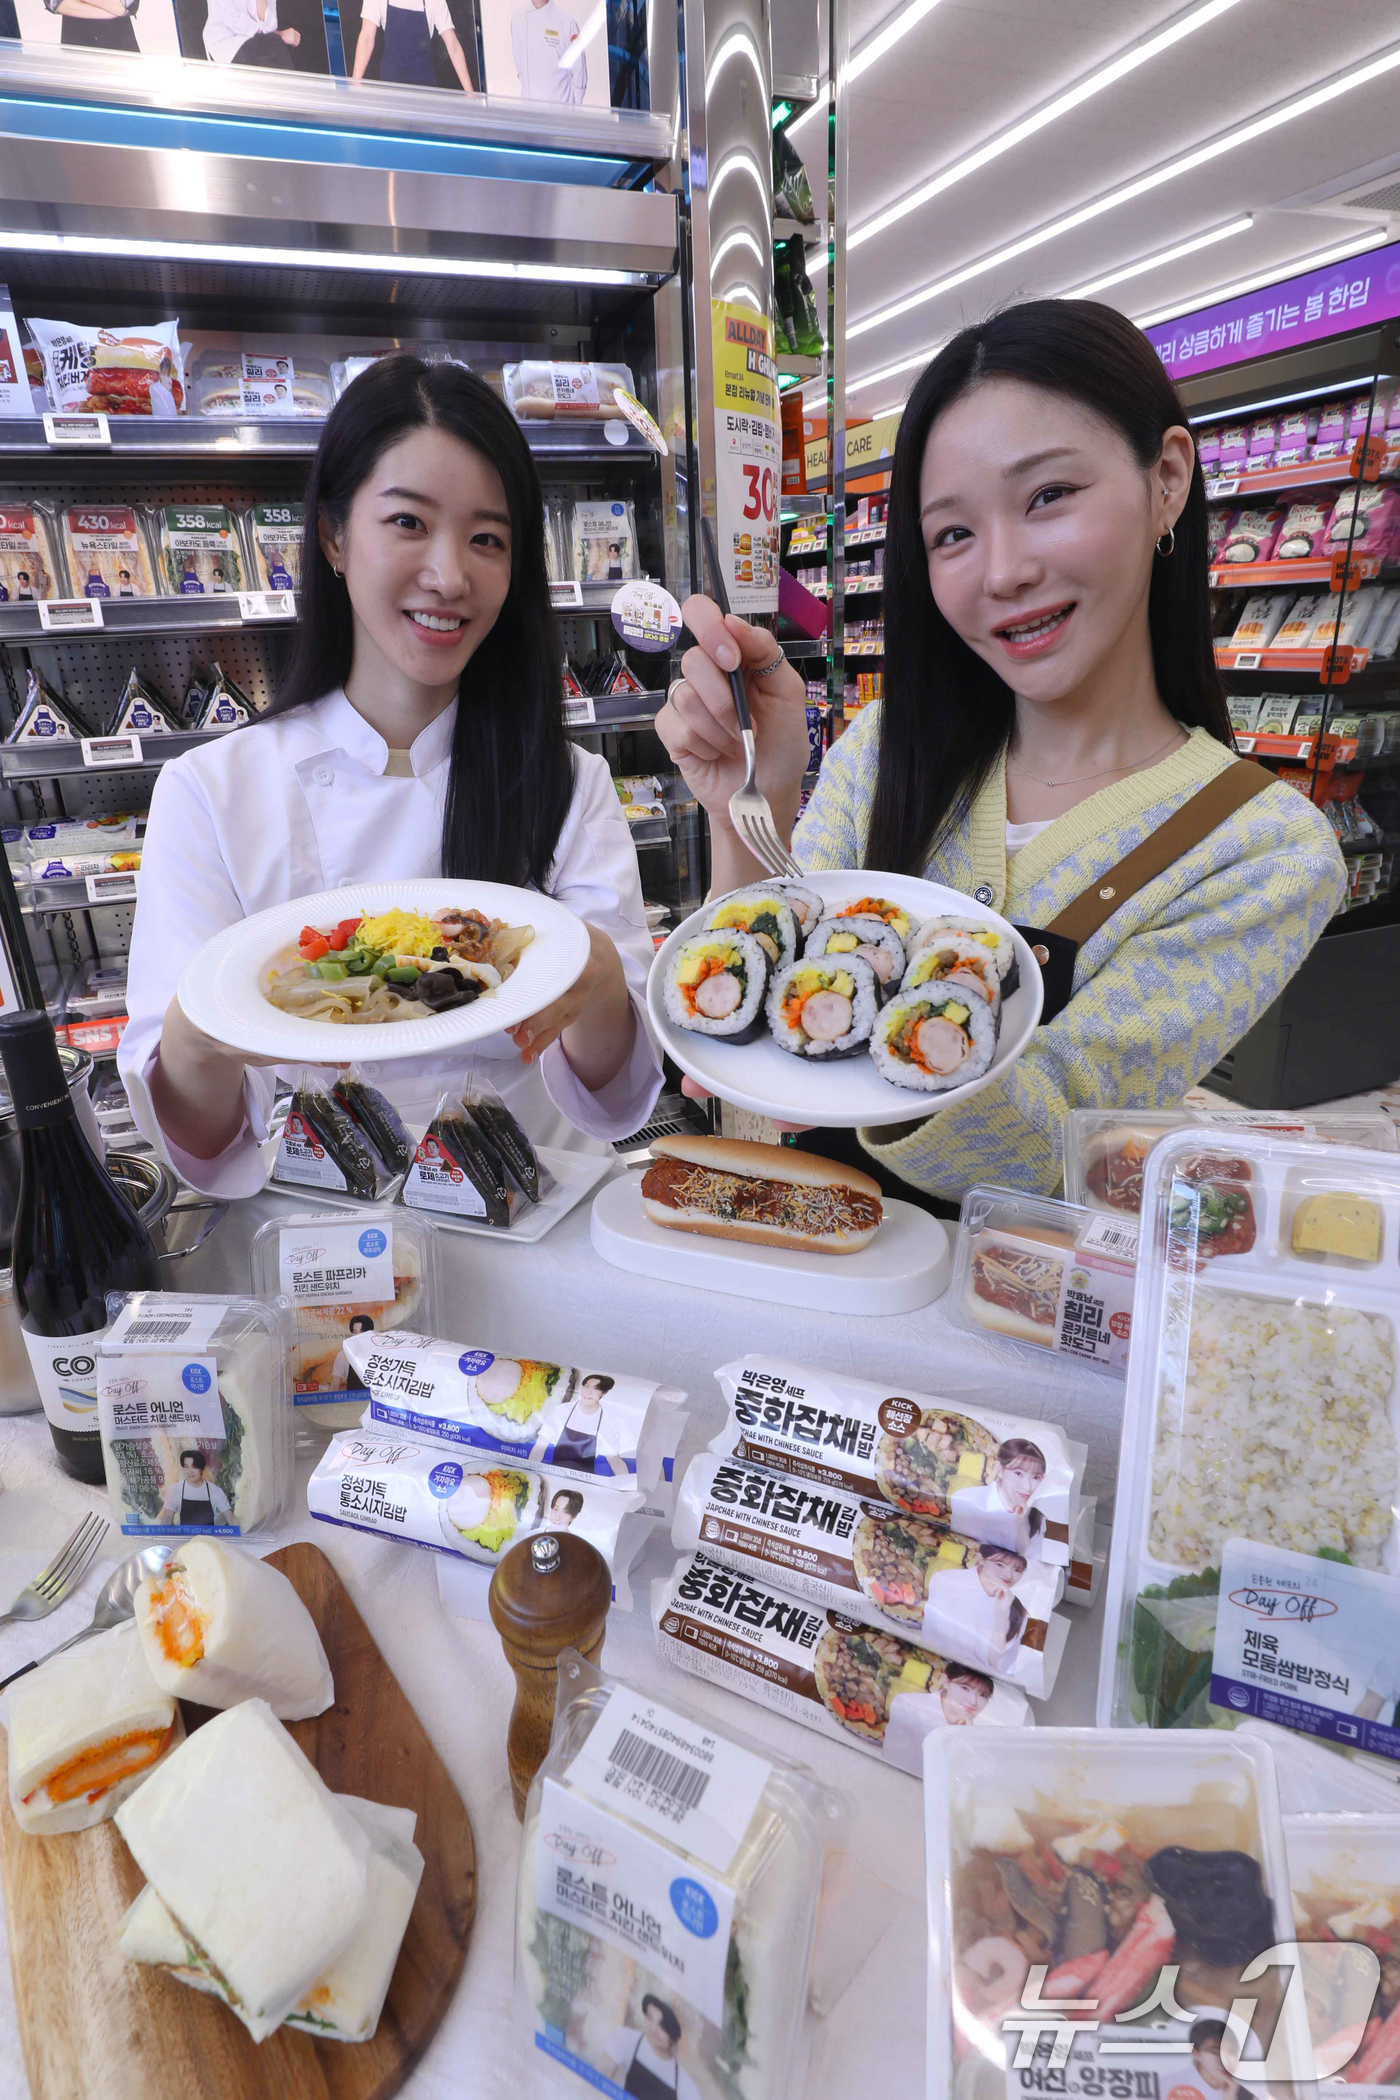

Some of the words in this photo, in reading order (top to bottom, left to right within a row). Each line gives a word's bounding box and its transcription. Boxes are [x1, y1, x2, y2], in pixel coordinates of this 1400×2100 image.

[1179, 318, 1243, 361] 상큼하게
[1246, 303, 1300, 340] 즐기는
[1304, 291, 1324, 323] 봄
[1328, 277, 1371, 316] 한입
[727, 320, 766, 350] ALLDAY
[725, 384, 738, 398] 본점
[739, 385, 756, 402] 리뉴얼
[847, 435, 873, 457] CARE
[78, 515, 110, 530] 430
[111, 521, 127, 530] kcal
[176, 514, 206, 529] 358
[206, 521, 222, 529] kcal
[263, 508, 292, 523] 358
[8, 520, 25, 530] kcal
[81, 541, 119, 550] 뉴욕스타일
[175, 539, 202, 548] 아보카도
[263, 534, 289, 542] 아보카도
[73, 1027, 112, 1046] SNS
[25, 1097, 65, 1112] CONVENIENT
[286, 1146, 300, 1155] 로제
[419, 1171, 435, 1181] 로제
[353, 1186, 359, 1195] 2
[288, 1255, 304, 1264] Day
[306, 1249, 319, 1262] Off
[293, 1270, 324, 1284] 로스트
[325, 1267, 367, 1282] 파프리카
[293, 1284, 309, 1293] 치킨
[309, 1281, 340, 1292] 샌드위치
[1067, 1289, 1094, 1304] 박효남
[1064, 1300, 1104, 1329] 칠리
[1062, 1320, 1111, 1346] 콘카르네
[382, 1335, 407, 1346] Day
[410, 1337, 438, 1349] Off
[1060, 1333, 1096, 1354] 핫도그
[1079, 1351, 1092, 1360] CARNE
[367, 1354, 417, 1377] 정성가득
[466, 1364, 478, 1372] 소스
[105, 1386, 122, 1396] Day
[125, 1381, 139, 1394] Off
[190, 1383, 205, 1391] 어니언
[363, 1369, 435, 1399] 통소시지김밥
[741, 1369, 788, 1394] 박은영
[785, 1385, 805, 1400] 셰프
[113, 1403, 148, 1416] 로스트
[150, 1400, 184, 1413] 어니언
[891, 1399, 913, 1412] KICK
[114, 1415, 149, 1425] 머스터드
[150, 1414, 167, 1423] 치킨
[168, 1413, 201, 1423] 샌드위치
[734, 1386, 861, 1456] 중화잡채
[856, 1422, 877, 1460] 김밥
[886, 1409, 914, 1424] 해선장
[887, 1421, 906, 1434] 소스
[351, 1442, 378, 1463] Day
[380, 1446, 408, 1465] Off
[757, 1434, 773, 1445] WITH
[773, 1438, 802, 1454] CHINESE
[802, 1446, 824, 1460] SAUCE
[442, 1465, 457, 1475] KICK
[341, 1474, 388, 1500] 정성가득
[433, 1474, 456, 1487] 겨자마요
[436, 1485, 447, 1494] 소스
[340, 1490, 408, 1523] 통소시지김밥
[710, 1466, 843, 1535] 중화잡채
[834, 1505, 858, 1539] 김밥
[339, 1508, 360, 1520] SAUSAGE
[360, 1514, 378, 1524] GIMBAP
[705, 1502, 735, 1519] JAPCHAE
[735, 1510, 751, 1523] WITH
[751, 1515, 780, 1532] CHINESE
[780, 1523, 802, 1539] SAUCE
[869, 1510, 887, 1520] 소스
[766, 1540, 791, 1554] 즉석섭취식품
[678, 1564, 808, 1641] 중화잡채
[799, 1615, 824, 1649] 김밥
[1243, 1588, 1280, 1616] Day
[1285, 1596, 1318, 1623] Off
[670, 1599, 698, 1617] JAPCHAE
[697, 1609, 713, 1623] WITH
[713, 1614, 742, 1634] CHINESE
[741, 1626, 764, 1643] SAUCE
[834, 1620, 854, 1632] 소스
[727, 1640, 751, 1657] 즉석섭취식품
[1243, 1629, 1280, 1655] 제육
[1242, 1649, 1350, 1696] 모둠쌈밥정식
[1242, 1670, 1279, 1688] STIR-FRIED
[1279, 1679, 1299, 1692] PORK
[553, 1832, 577, 1858] Day
[581, 1845, 603, 1867] Off
[557, 1865, 609, 1904] 로스트
[613, 1893, 662, 1943] 어니언
[1079, 2066, 1161, 2100] 양장피
